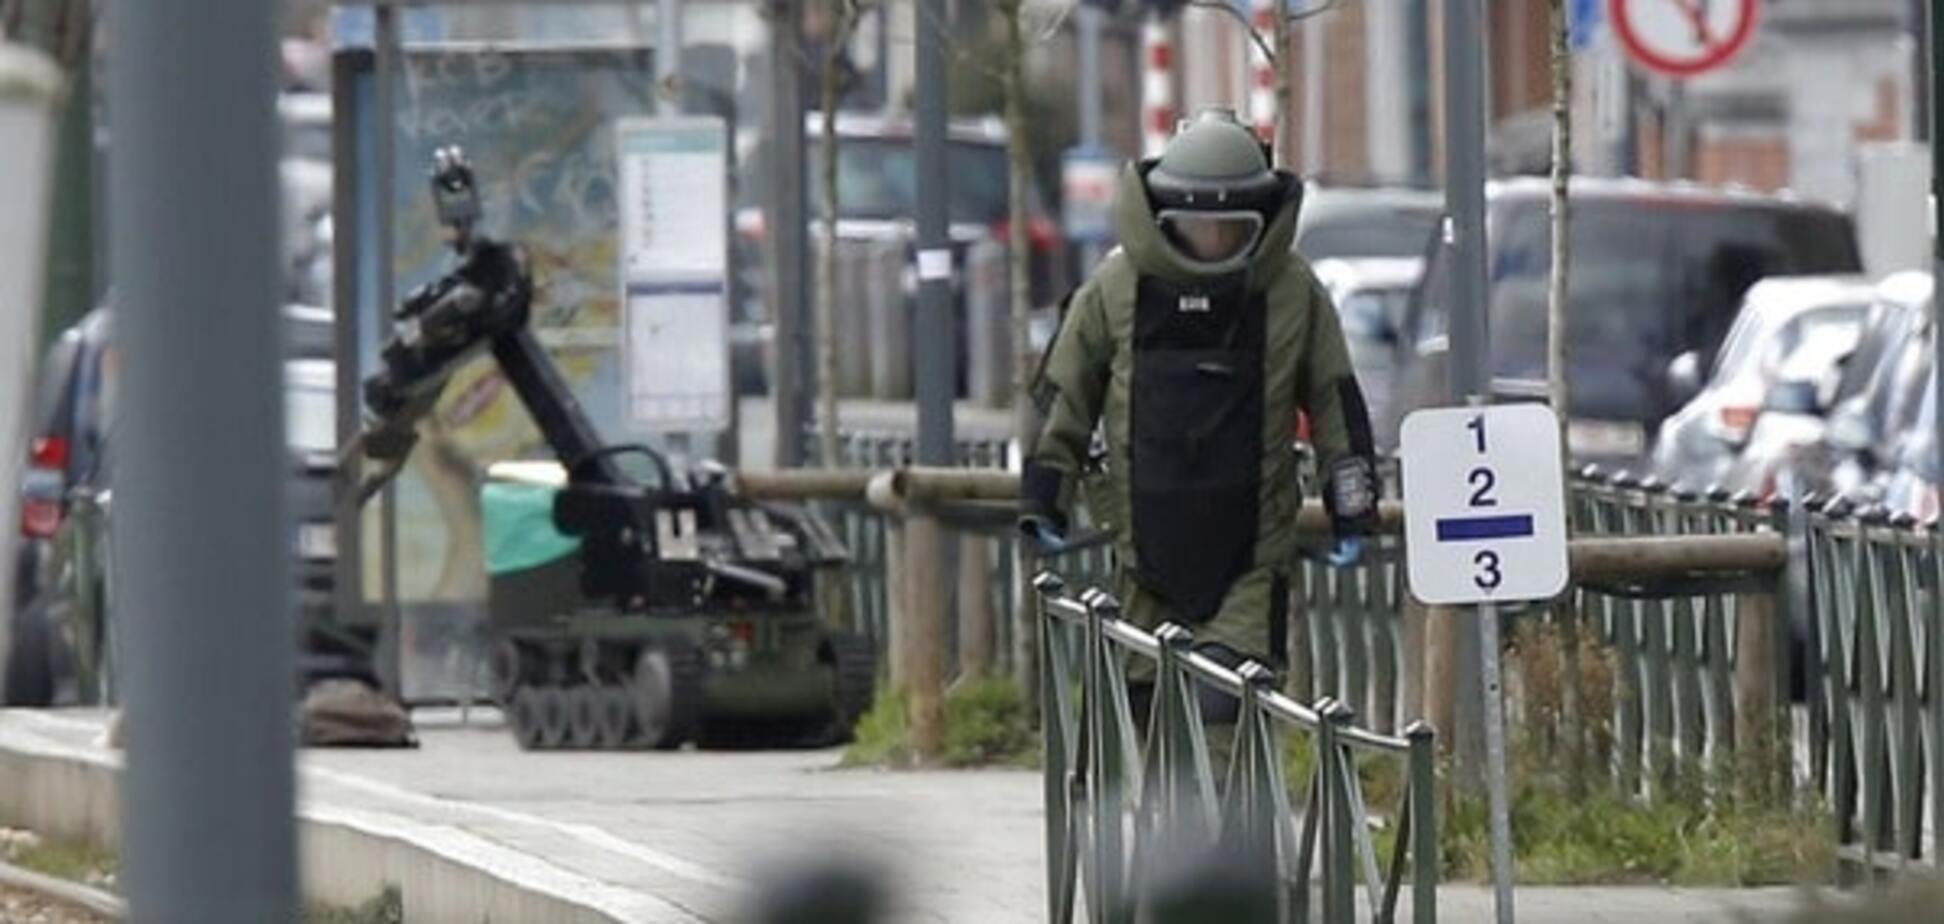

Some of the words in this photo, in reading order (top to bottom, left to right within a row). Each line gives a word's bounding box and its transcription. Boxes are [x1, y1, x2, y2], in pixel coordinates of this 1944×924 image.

[1466, 414, 1486, 453] 1
[1468, 466, 1497, 507] 2
[1473, 550, 1502, 589] 3
